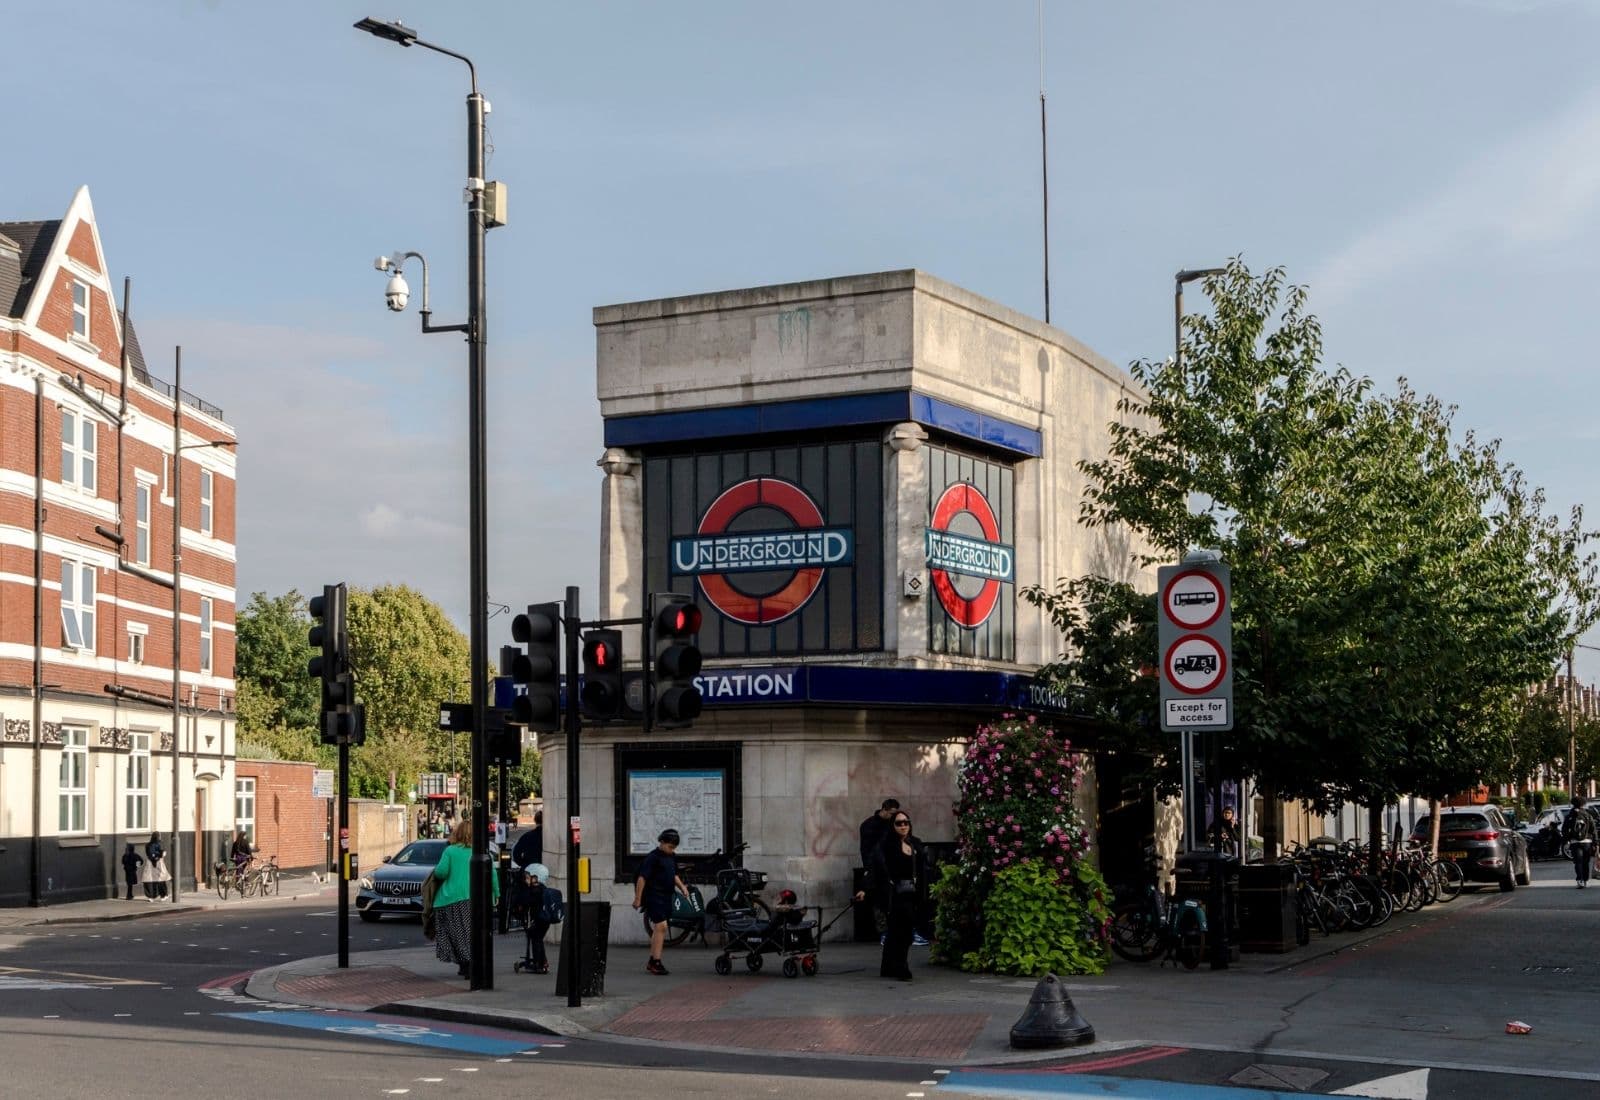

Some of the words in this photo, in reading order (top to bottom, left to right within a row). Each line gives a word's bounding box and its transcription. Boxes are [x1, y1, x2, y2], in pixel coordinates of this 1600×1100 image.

[675, 532, 847, 571] UNDERGROUND
[692, 673, 793, 697] STATION
[1170, 703, 1204, 712] Except
[1208, 702, 1223, 711] for
[1180, 714, 1214, 722] access
